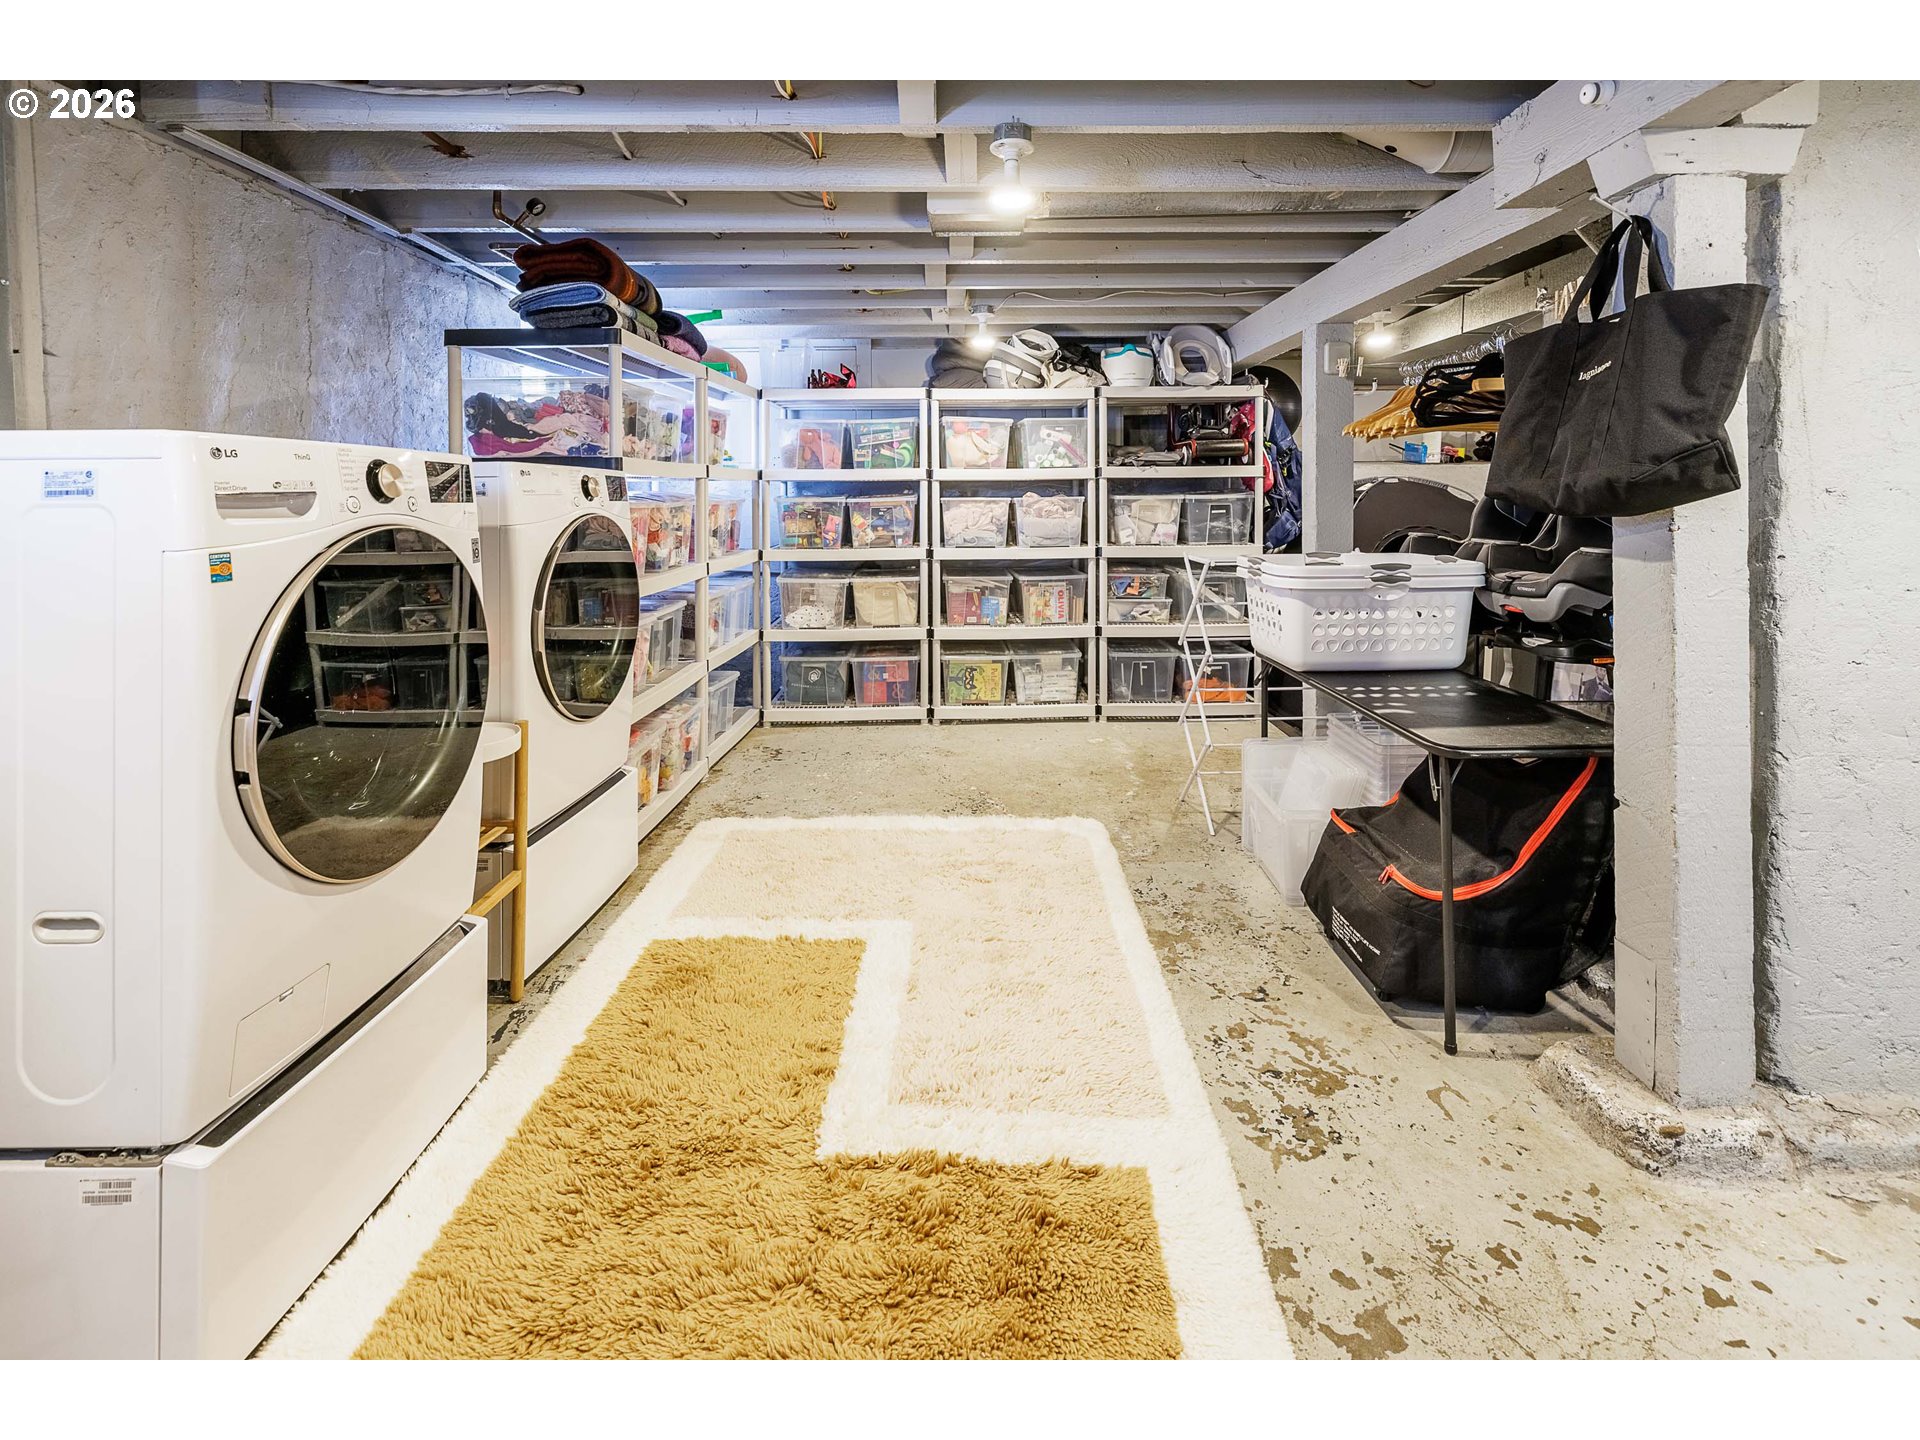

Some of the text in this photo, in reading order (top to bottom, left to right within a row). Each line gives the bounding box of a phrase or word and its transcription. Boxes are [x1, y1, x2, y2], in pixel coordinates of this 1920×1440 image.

[224, 449, 238, 458] LG
[293, 453, 311, 461] ThinQ
[1057, 588, 1065, 620] OLIVIA
